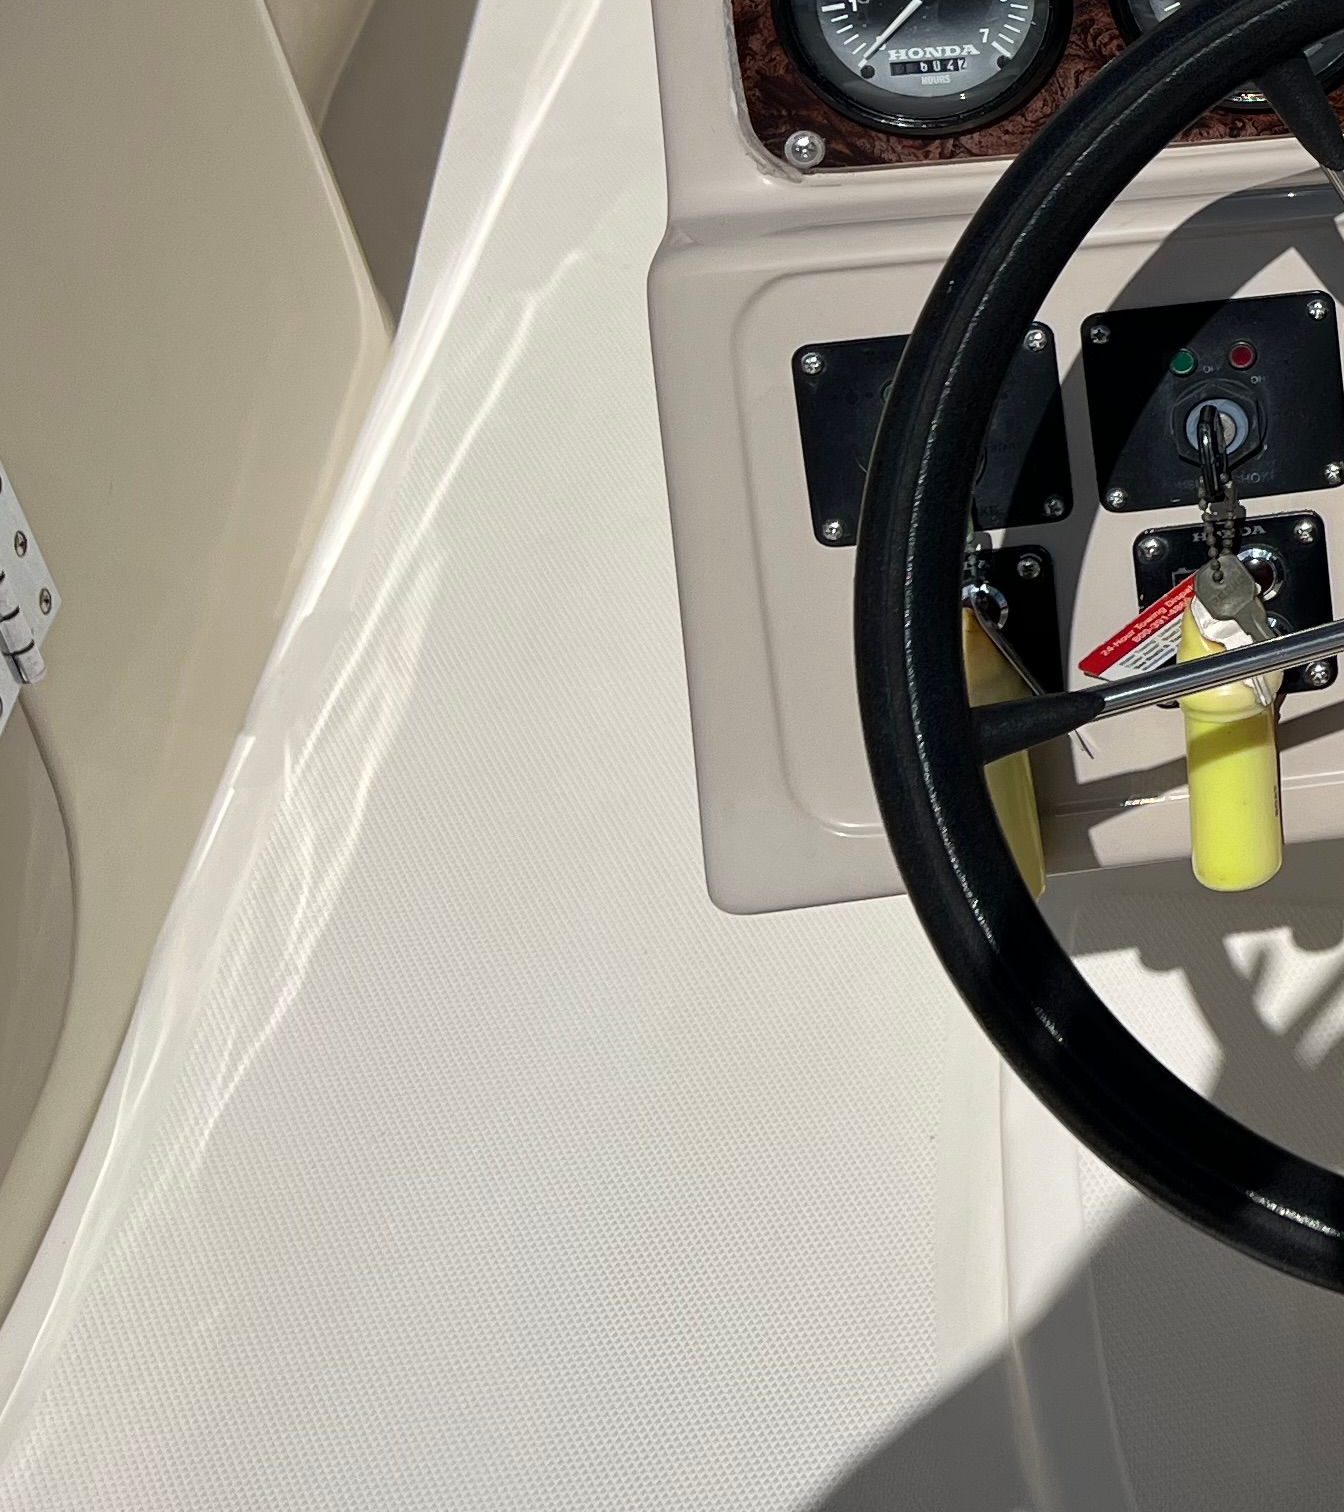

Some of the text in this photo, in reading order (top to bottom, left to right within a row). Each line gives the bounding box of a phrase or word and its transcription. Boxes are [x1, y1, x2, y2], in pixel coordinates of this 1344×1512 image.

[979, 29, 990, 43] 7
[887, 43, 980, 61] HONDA
[921, 76, 951, 86] HOURS
